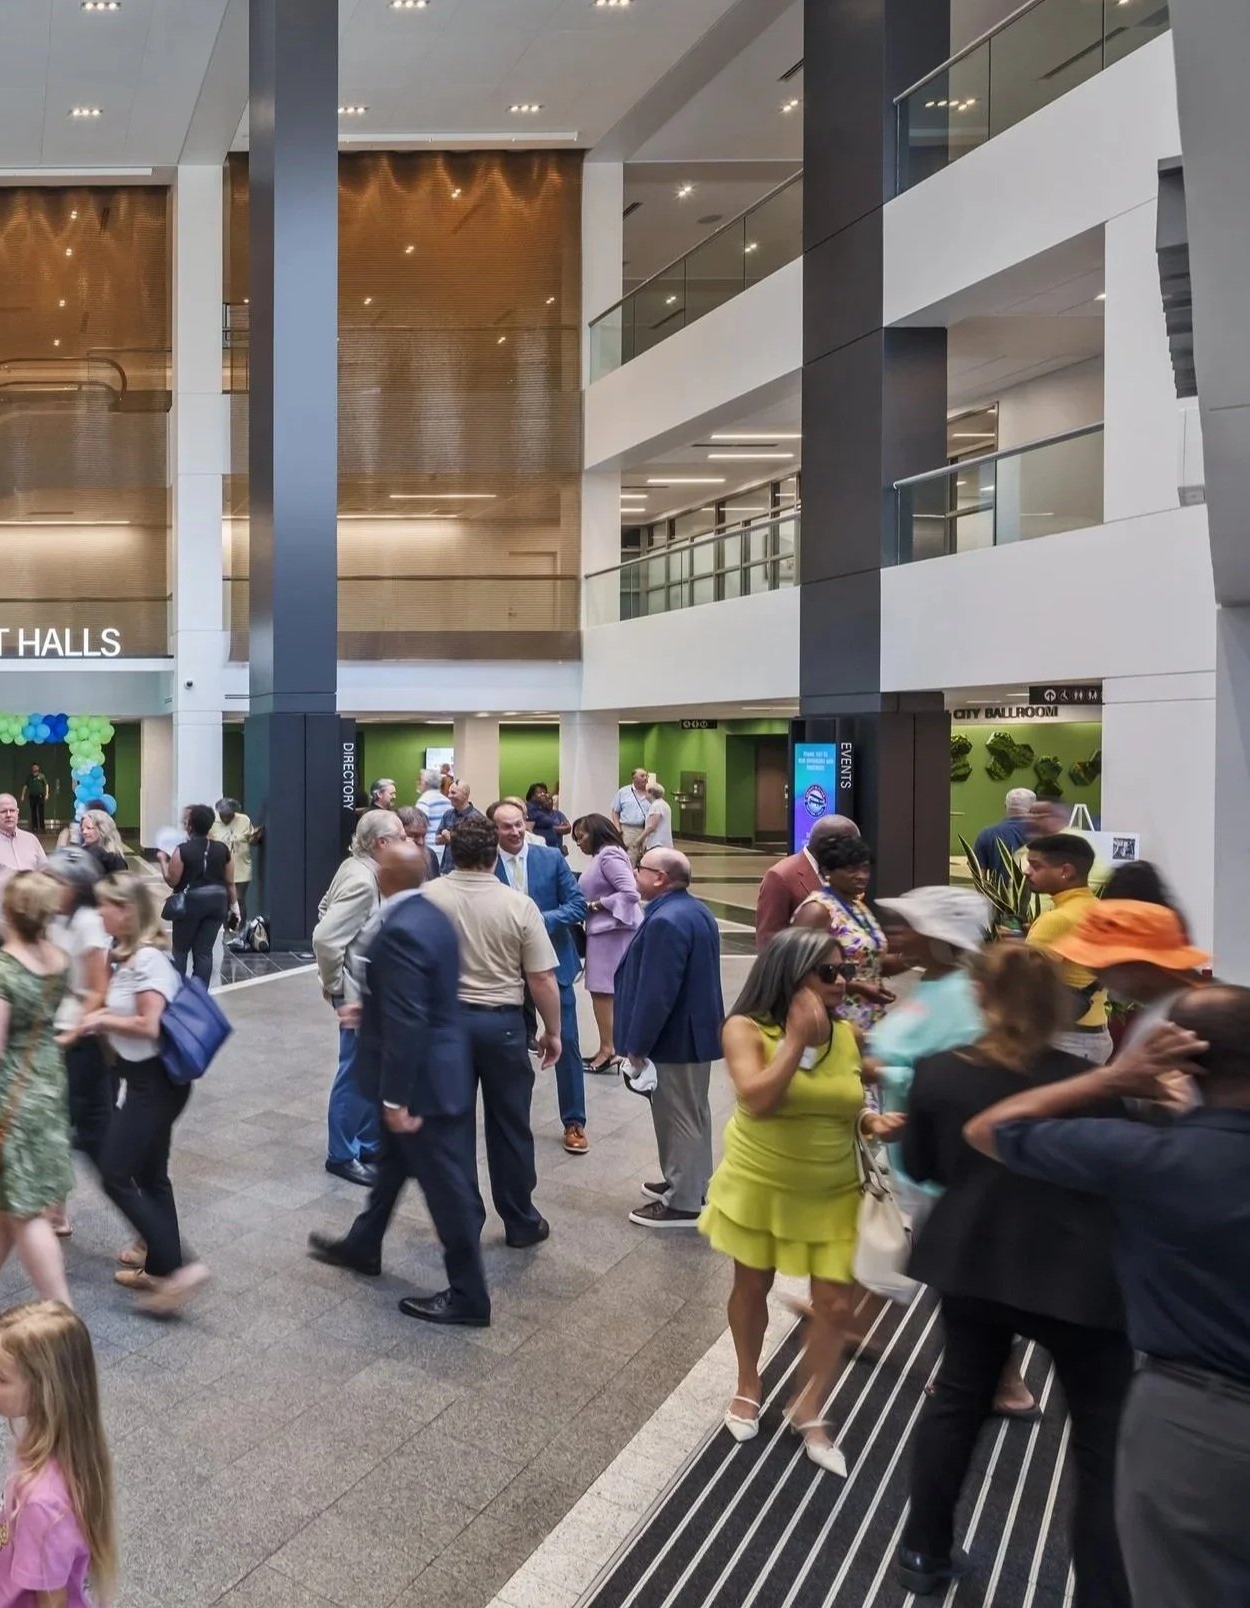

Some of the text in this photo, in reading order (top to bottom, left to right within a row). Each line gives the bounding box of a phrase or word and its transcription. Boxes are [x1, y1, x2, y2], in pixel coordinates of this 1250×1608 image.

[18, 628, 121, 657] HALLS
[953, 706, 1058, 720] CITY BALLROOM
[343, 742, 355, 811] DIRECTORY
[840, 742, 853, 790] EVENTS
